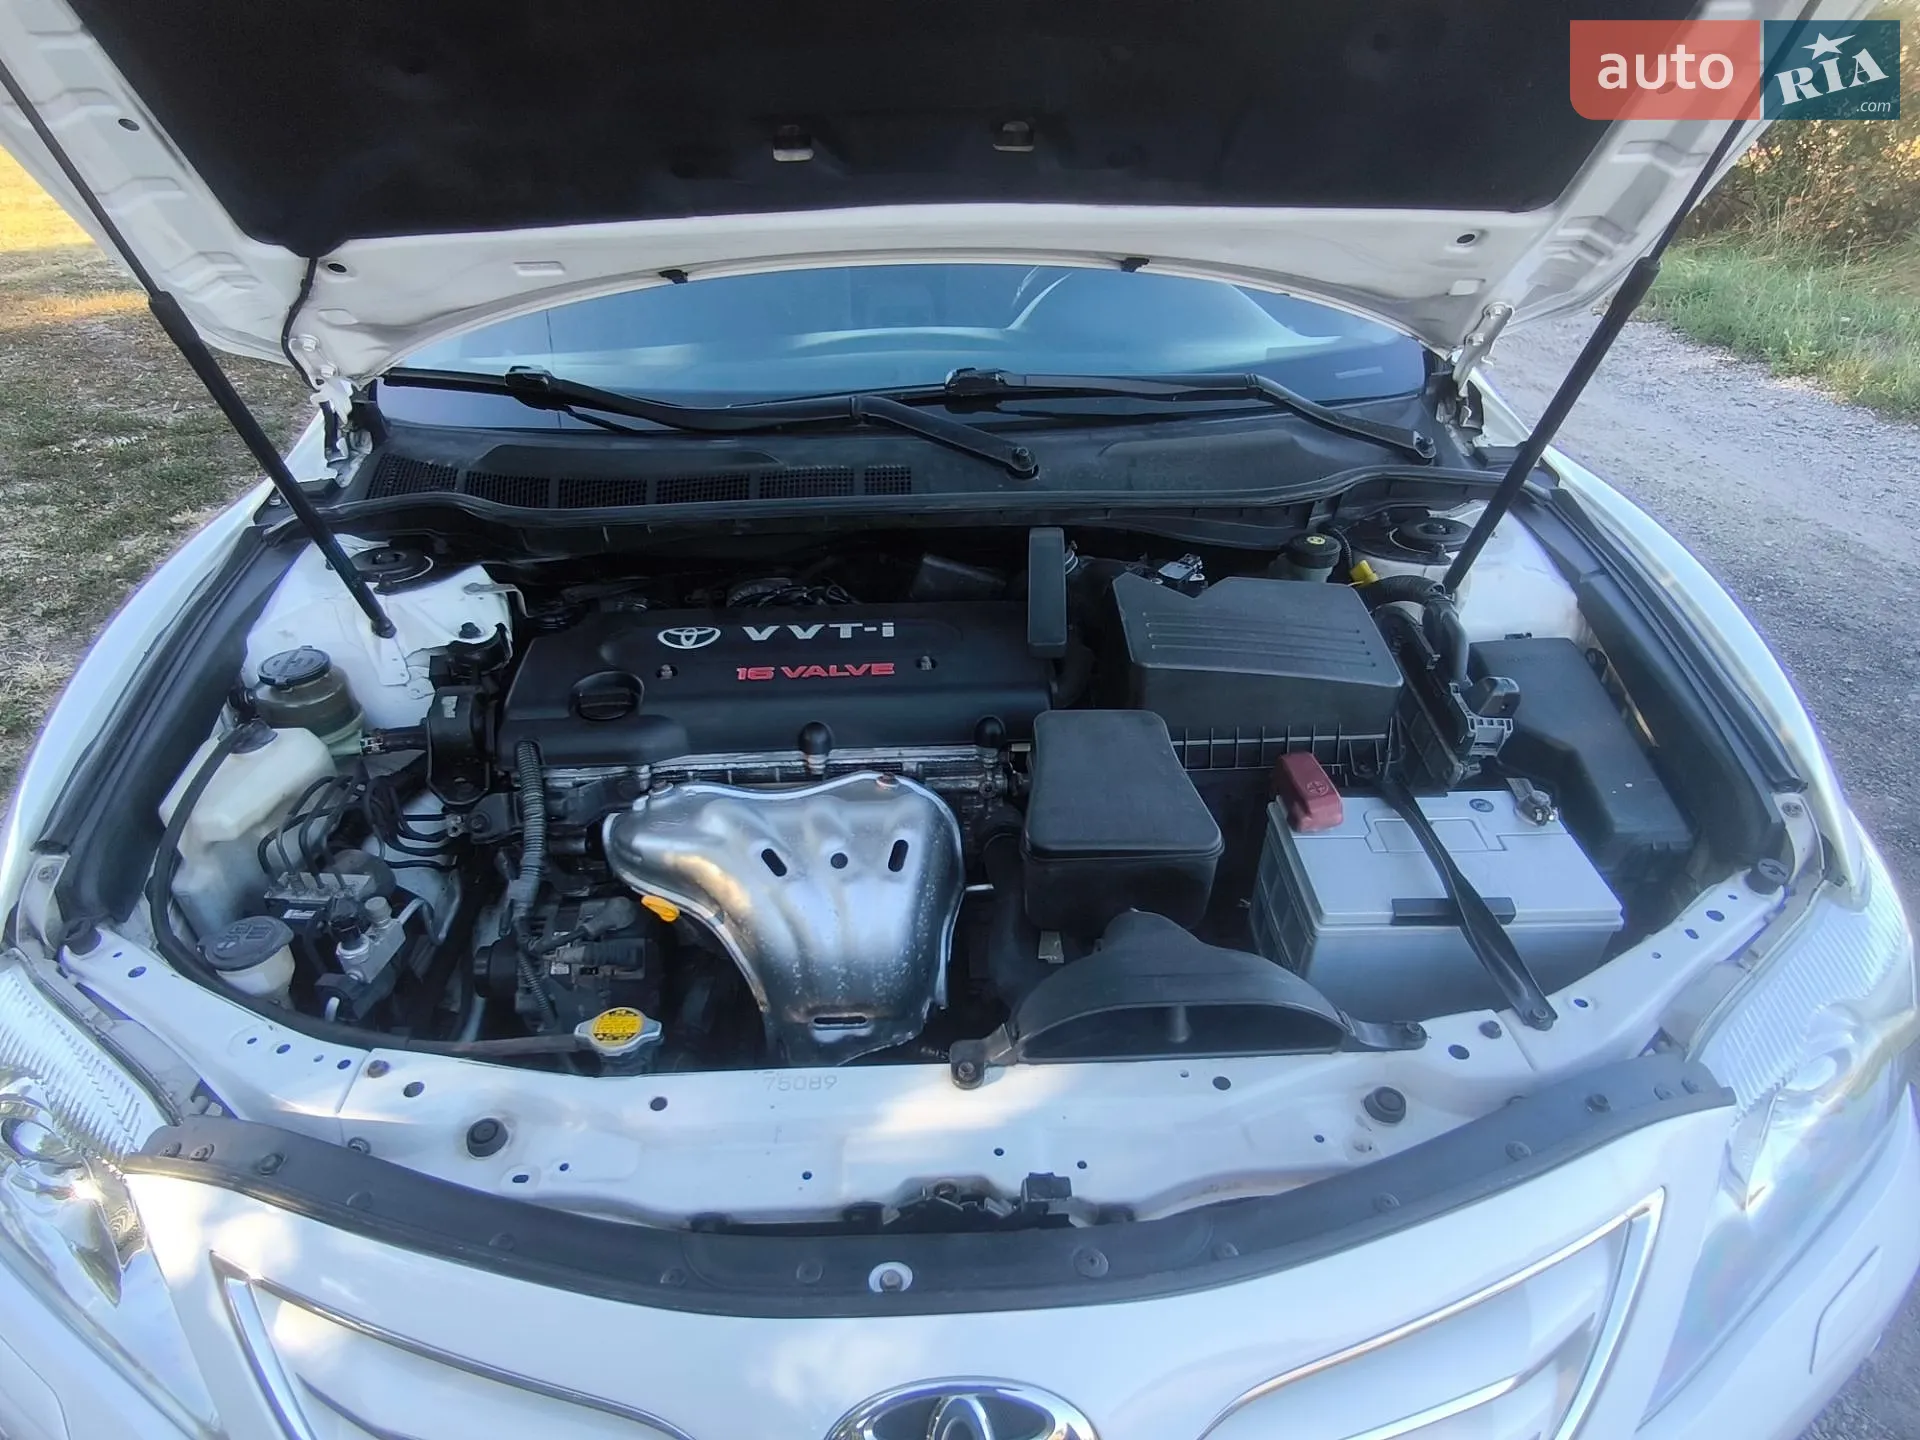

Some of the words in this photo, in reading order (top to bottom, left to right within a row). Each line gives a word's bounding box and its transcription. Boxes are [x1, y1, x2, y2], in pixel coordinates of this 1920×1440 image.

[742, 622, 895, 641] VVT-i
[736, 666, 775, 681] 16
[780, 662, 896, 679] VALVE
[763, 1074, 838, 1092] 75089
